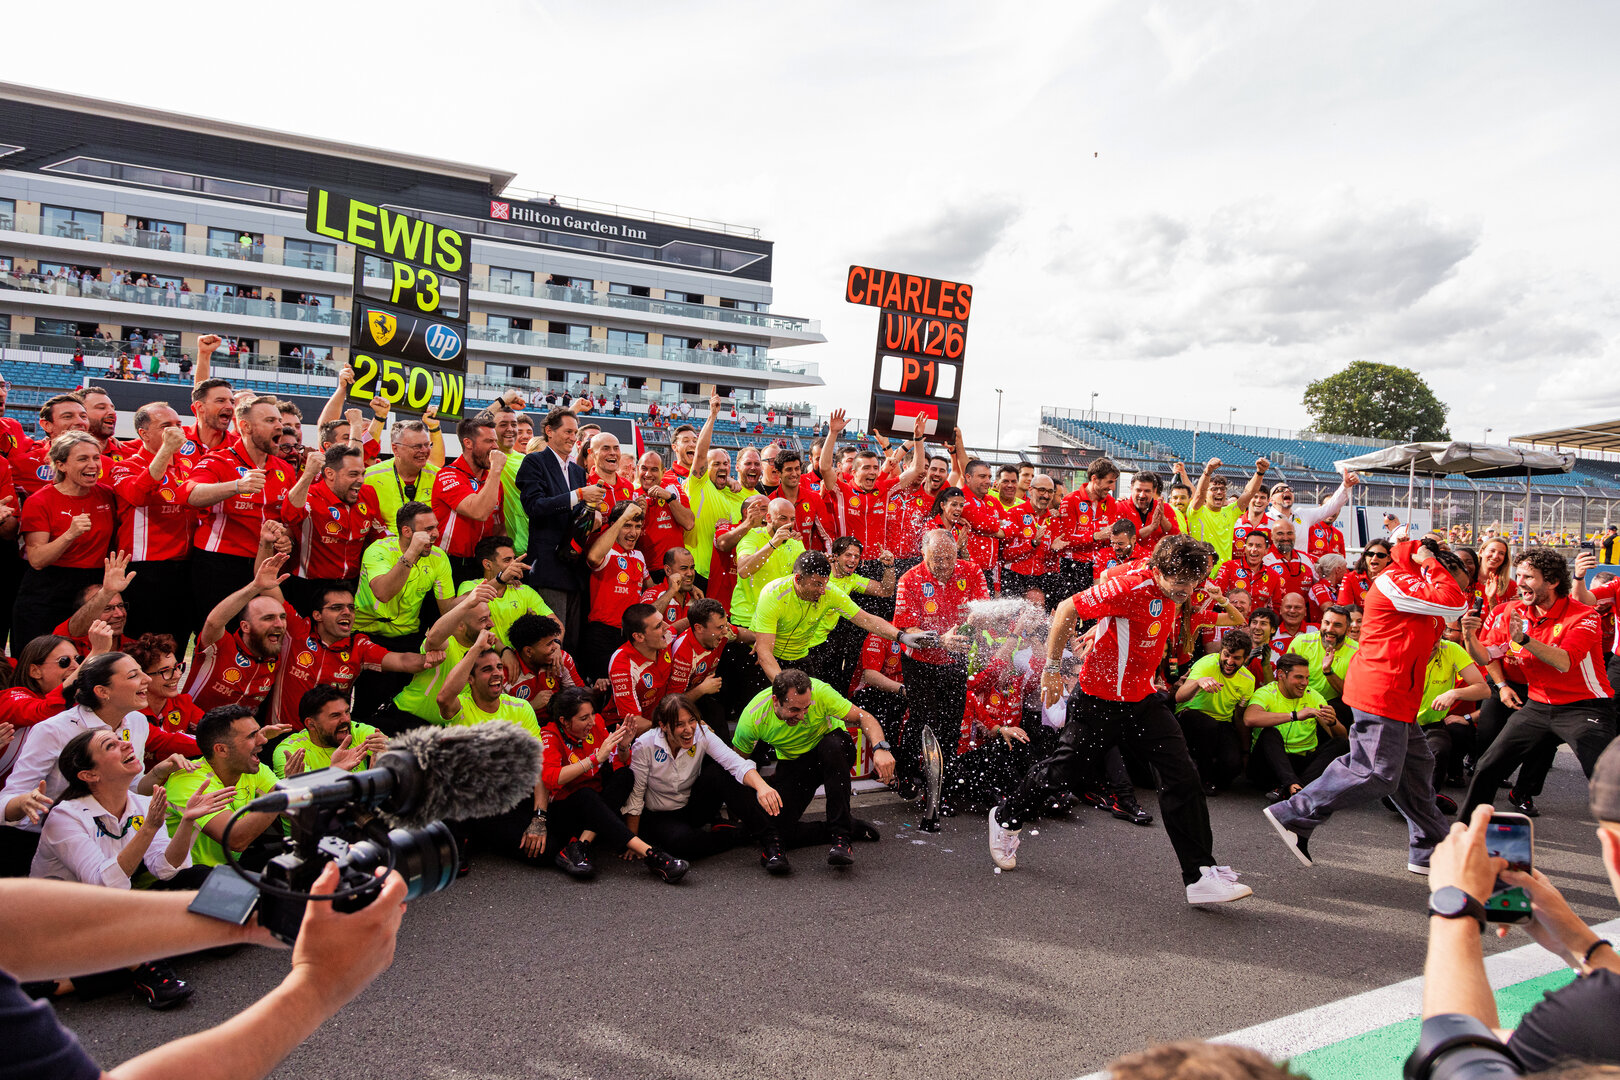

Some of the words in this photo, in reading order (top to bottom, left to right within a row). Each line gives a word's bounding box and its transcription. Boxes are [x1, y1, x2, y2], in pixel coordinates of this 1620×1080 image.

[512, 206, 560, 226] Hilton
[563, 215, 618, 236] Garden
[622, 225, 647, 240] Inn
[316, 189, 463, 273] LEWIS
[391, 260, 440, 312] P3
[847, 266, 972, 321] CHARLES
[429, 325, 457, 360] hp
[901, 357, 935, 396] P1
[161, 505, 180, 514] IBM
[235, 501, 254, 510] IBM
[614, 586, 629, 594] IBM
[923, 582, 933, 597] hp
[1151, 599, 1161, 617] hp
[1139, 639, 1158, 647] IBM
[289, 666, 310, 681] IBM
[212, 681, 235, 696] IBM
[518, 686, 529, 699] hp
[655, 749, 667, 762] hp
